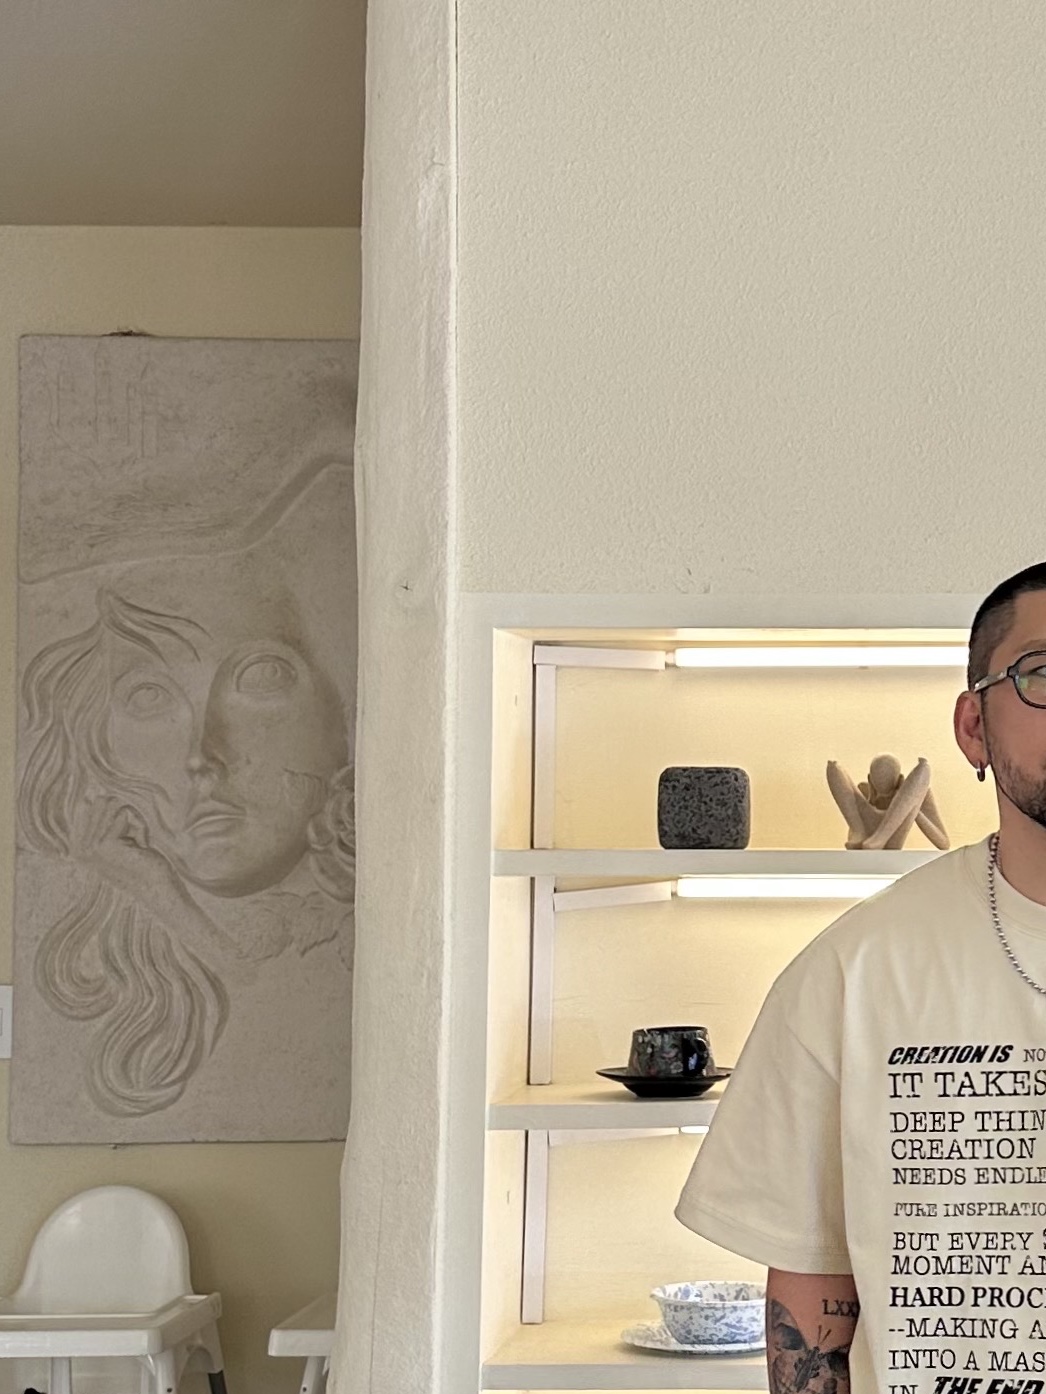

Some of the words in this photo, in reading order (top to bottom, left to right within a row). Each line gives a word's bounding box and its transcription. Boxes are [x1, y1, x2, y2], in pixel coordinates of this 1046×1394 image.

[888, 1045, 989, 1065] CREATION
[988, 1045, 1013, 1063] IS
[888, 1072, 923, 1098] IT
[934, 1069, 1046, 1098] TAKES
[890, 1111, 965, 1132] DEEP
[891, 1138, 1036, 1160] CREATION
[892, 1167, 966, 1185] NEEDS
[893, 1202, 937, 1217] PURE
[893, 1231, 939, 1251] BUT
[947, 1231, 1034, 1250] EVERY
[891, 1255, 1011, 1275] MOMENT
[889, 1286, 965, 1307] HARD
[888, 1349, 956, 1370] INTO
[963, 1350, 980, 1371] A
